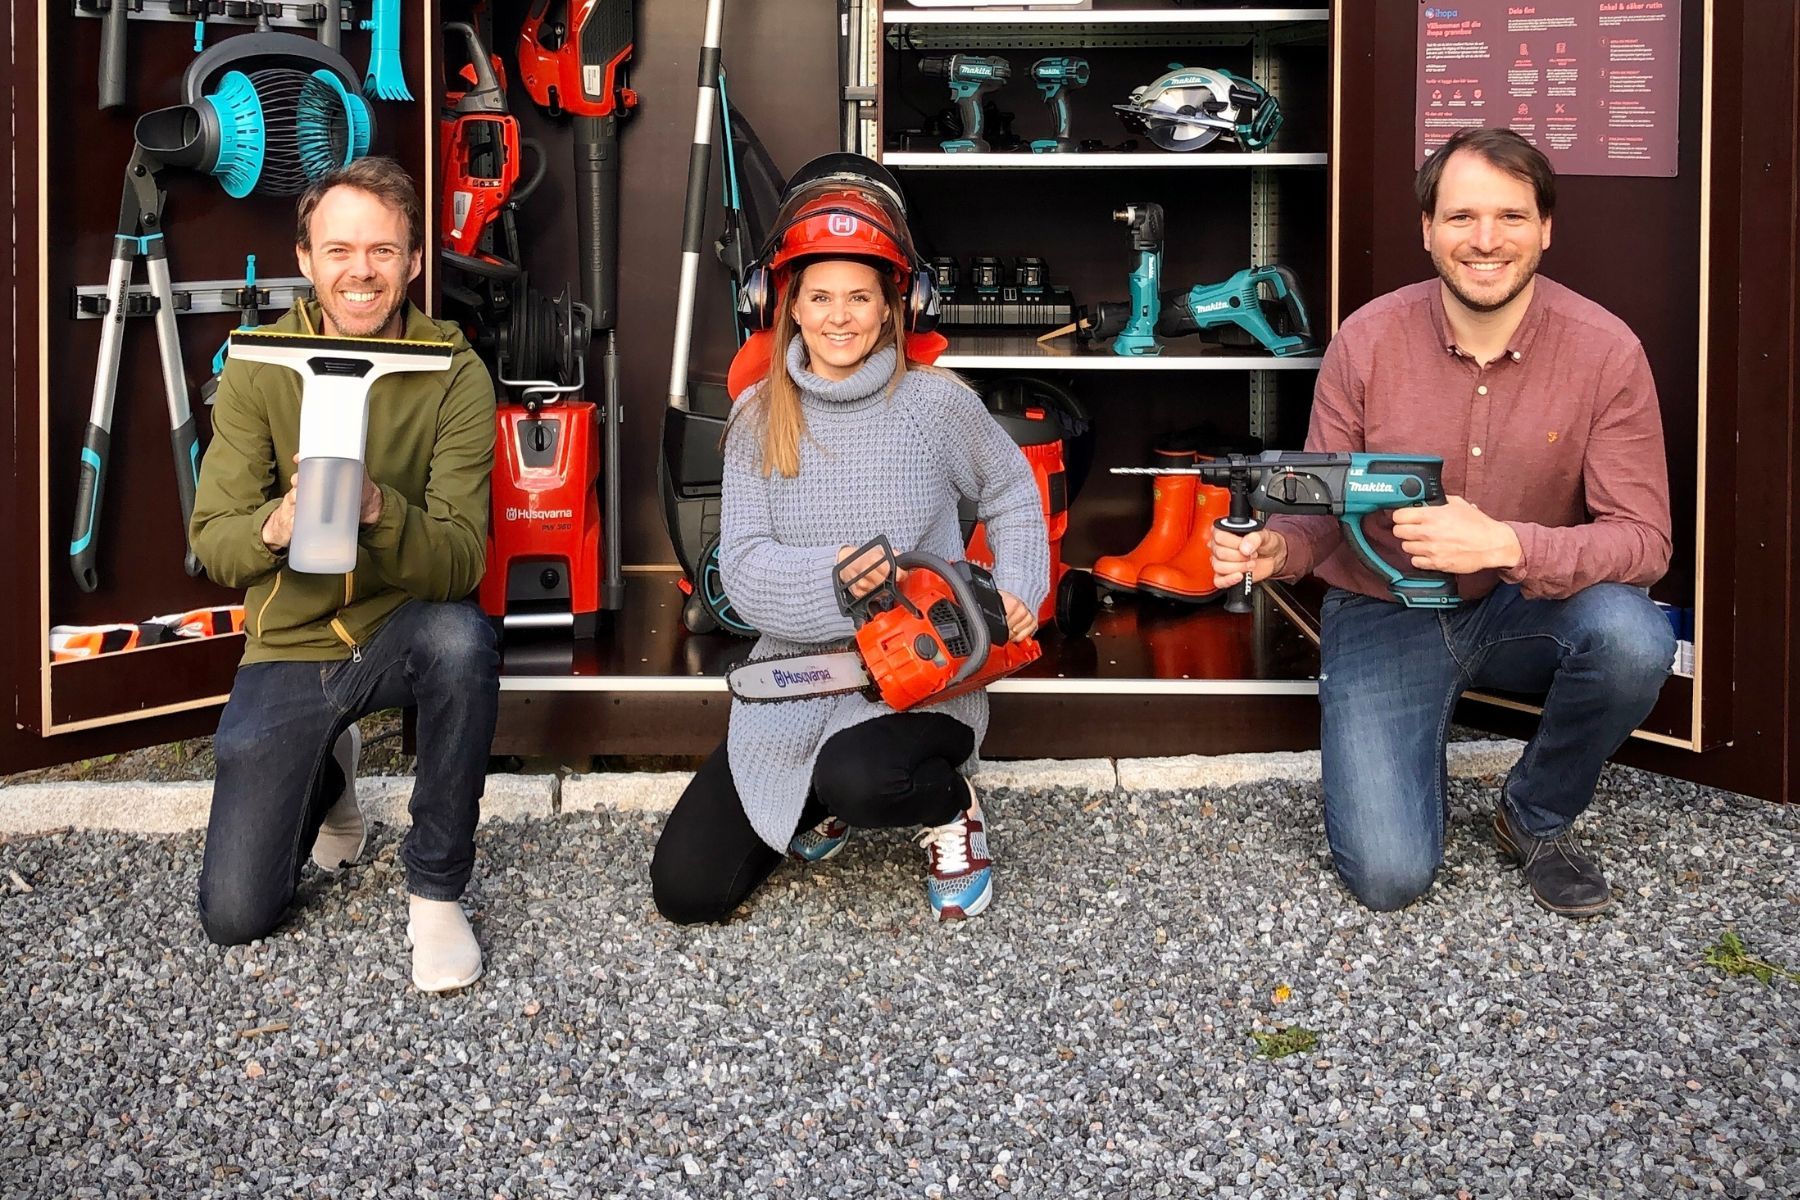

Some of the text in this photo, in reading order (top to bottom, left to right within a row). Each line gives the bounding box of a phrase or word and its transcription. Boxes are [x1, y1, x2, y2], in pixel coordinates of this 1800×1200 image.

[1619, 3, 1625, 11] &
[1435, 8, 1458, 19] ihopa
[117, 280, 128, 313] GARDENA
[518, 509, 572, 520] Husqvarna
[783, 668, 832, 685] Husqvarna
